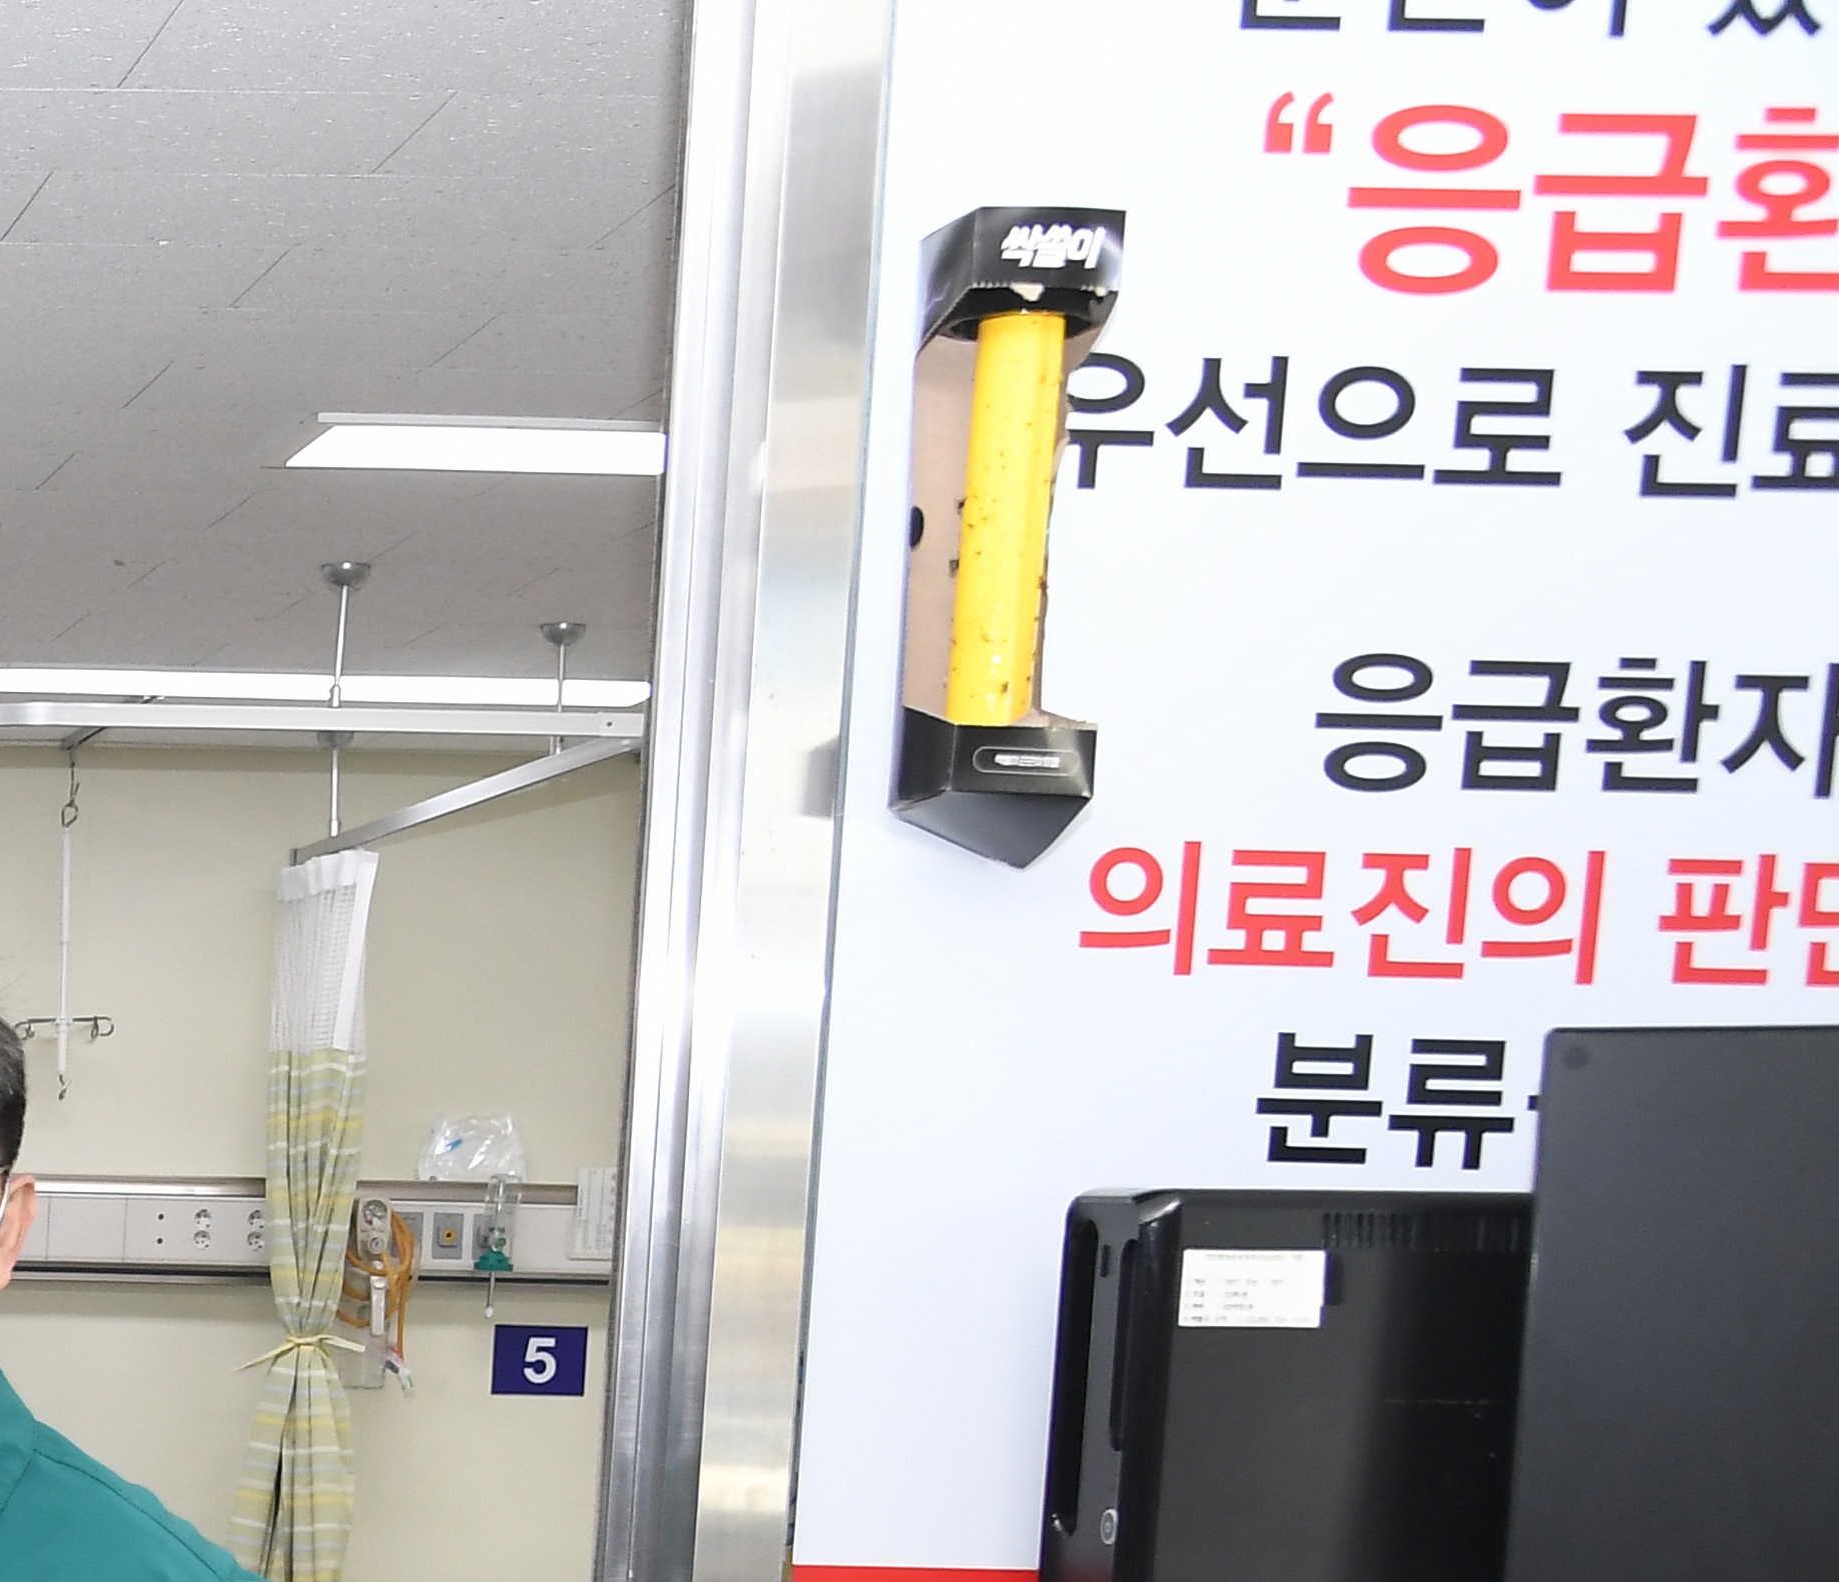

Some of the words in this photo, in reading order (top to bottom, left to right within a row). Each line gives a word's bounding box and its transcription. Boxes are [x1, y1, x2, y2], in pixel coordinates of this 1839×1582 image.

[1078, 841, 1607, 985] 의료진의
[1256, 1032, 1541, 1169] 분류
[524, 1337, 557, 1384] 5
